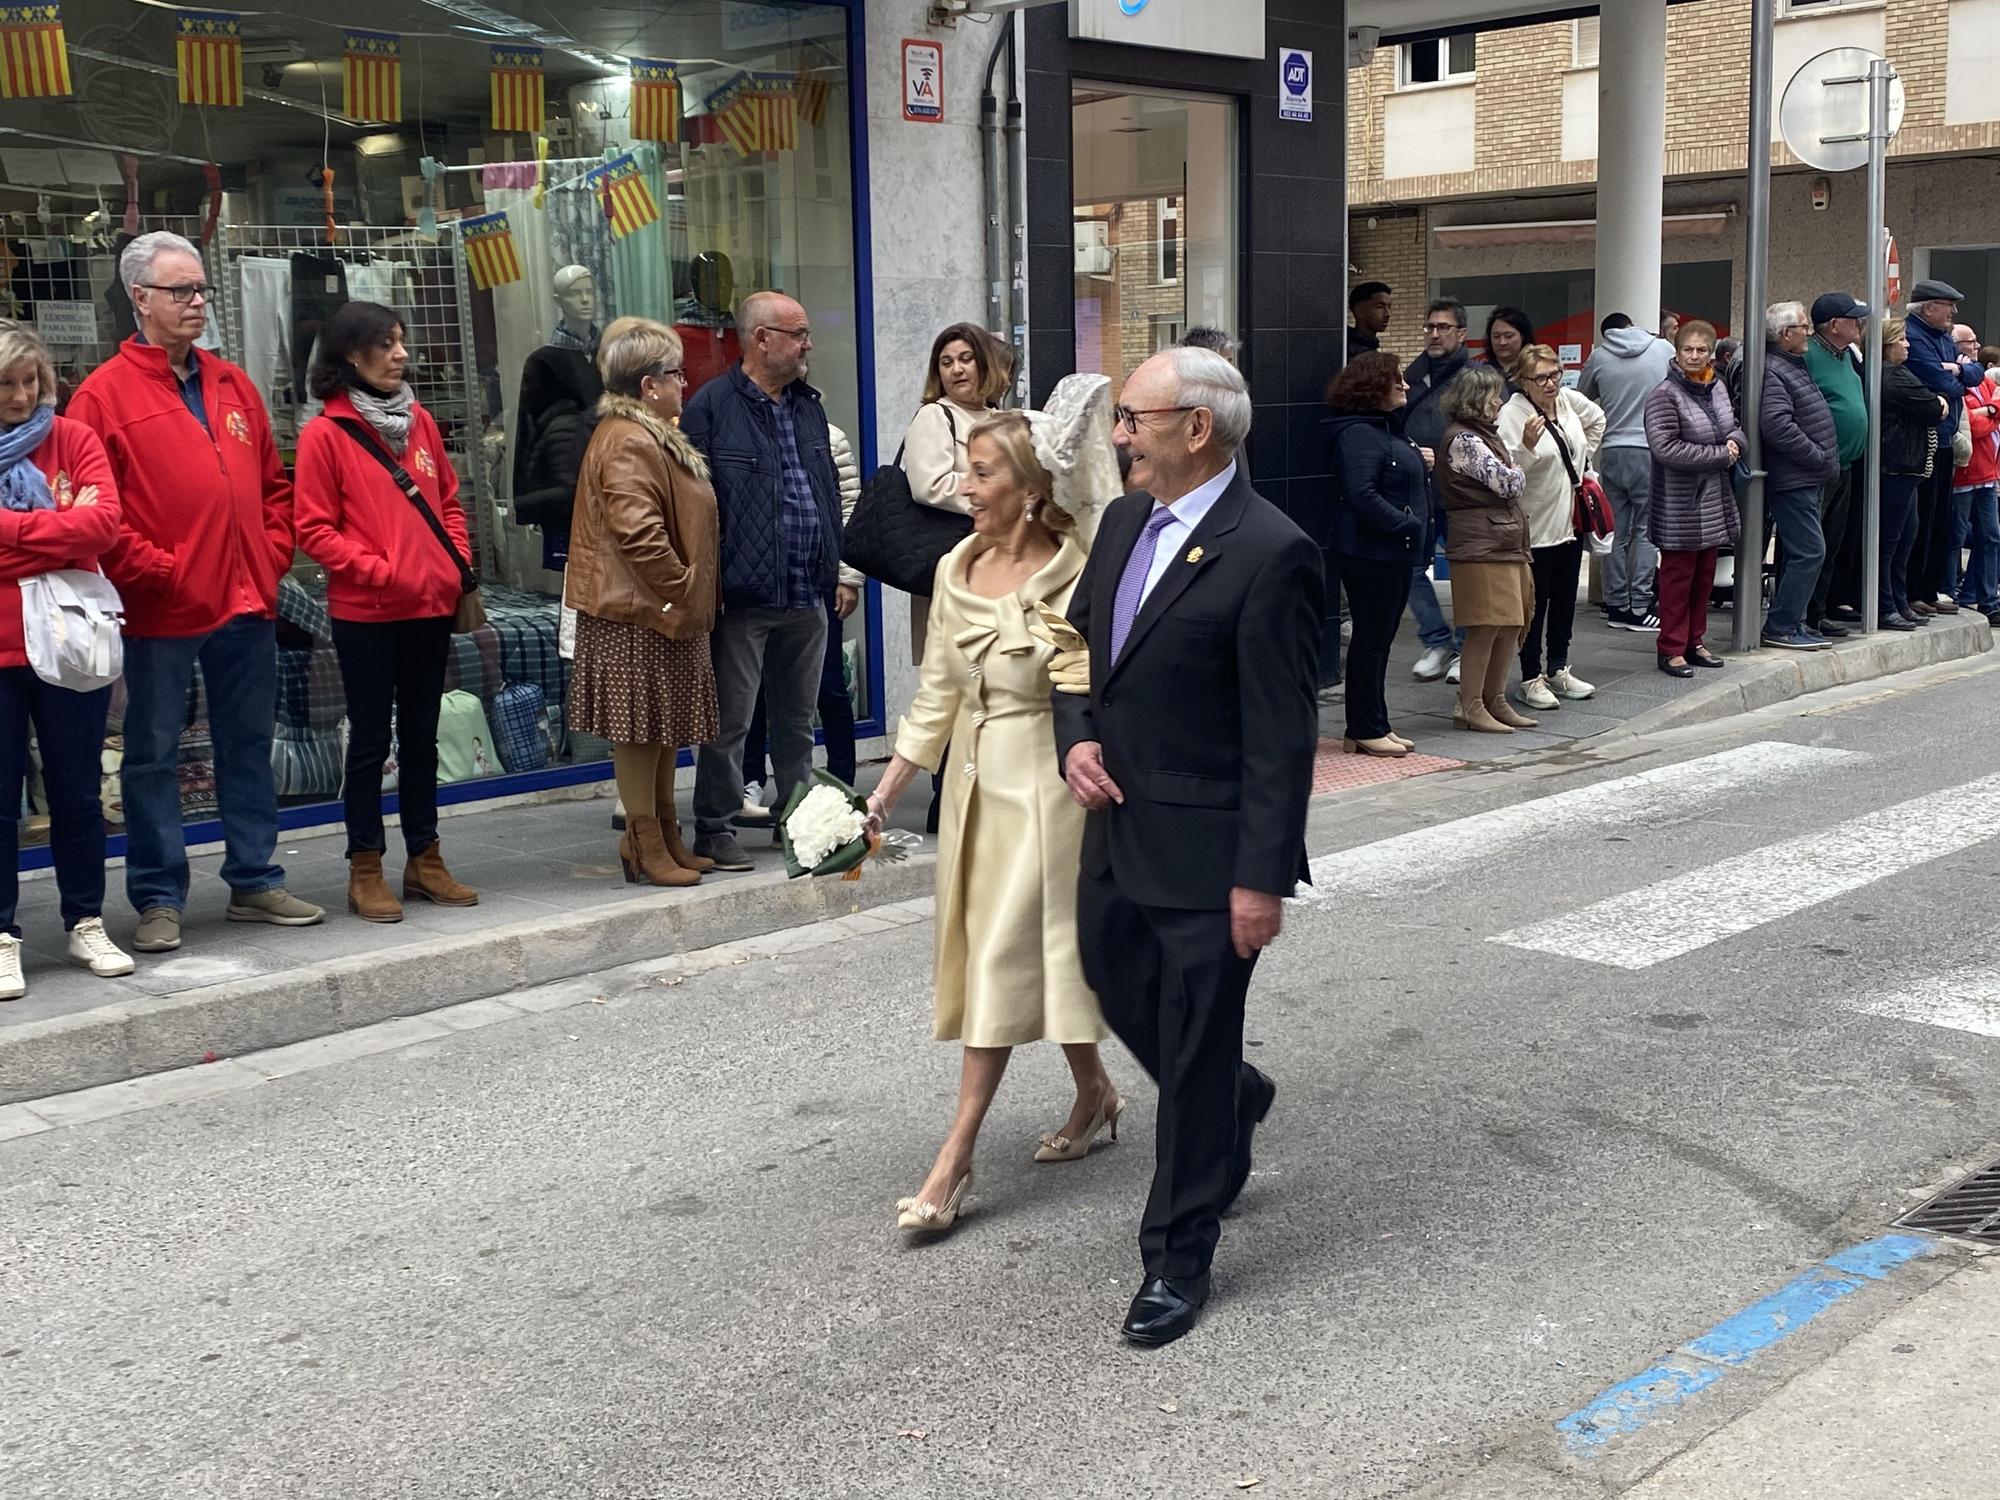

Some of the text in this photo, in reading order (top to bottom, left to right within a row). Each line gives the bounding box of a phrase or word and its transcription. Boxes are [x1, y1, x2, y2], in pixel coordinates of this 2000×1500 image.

[1288, 67, 1305, 82] ADT
[912, 80, 934, 97] VA
[40, 303, 92, 311] CAMISETAS
